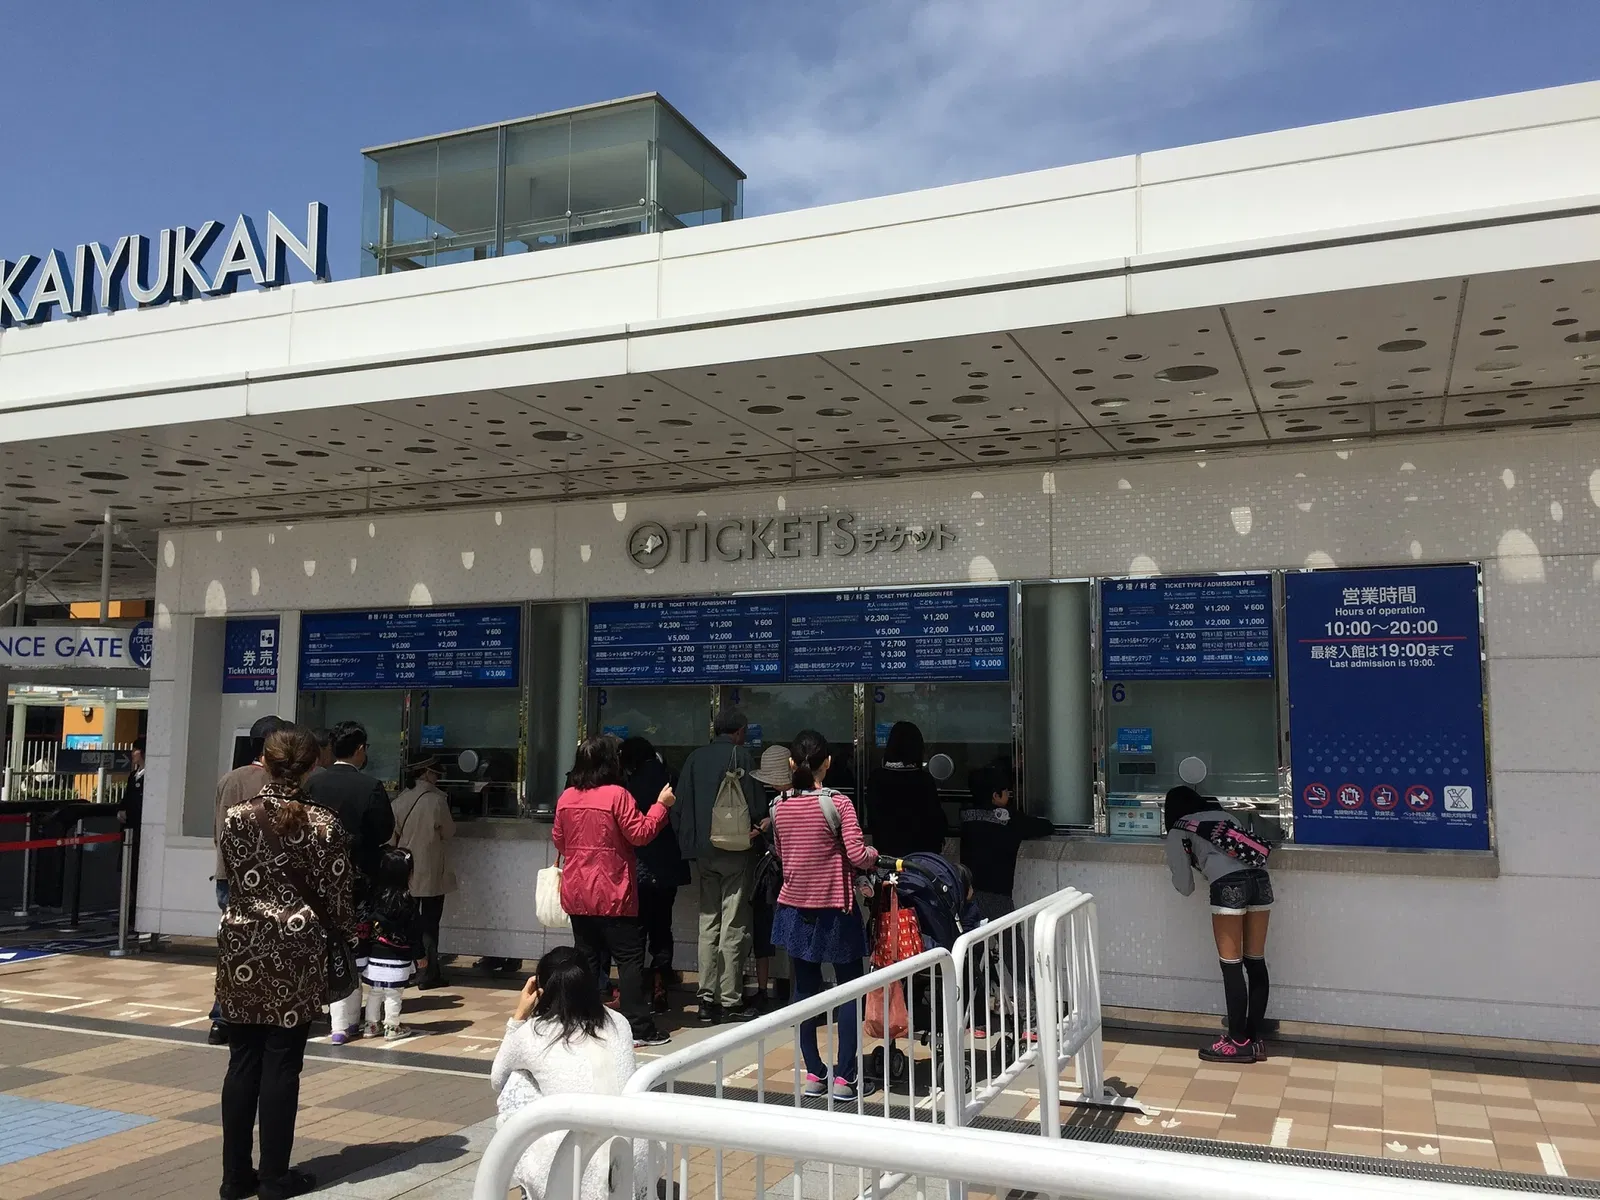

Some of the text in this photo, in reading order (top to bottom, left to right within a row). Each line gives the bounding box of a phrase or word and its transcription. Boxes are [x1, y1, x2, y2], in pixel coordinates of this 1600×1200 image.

[0, 201, 328, 323] KAIYUKAN
[672, 512, 956, 563] TICKETS チケット
[1343, 586, 1416, 606] 営業時間
[1335, 608, 1364, 616] Hours
[1378, 606, 1425, 616] operation
[55, 637, 122, 657] GATE
[1310, 643, 1454, 659] 最終入館は19:00まで
[243, 650, 280, 666] 券売
[1330, 660, 1348, 668] Last
[1351, 659, 1396, 667] admission
[1409, 659, 1435, 667] 19:00.
[249, 667, 275, 675] Vending
[730, 688, 740, 704] 4
[874, 688, 885, 703] 5
[1112, 683, 1125, 702] 6
